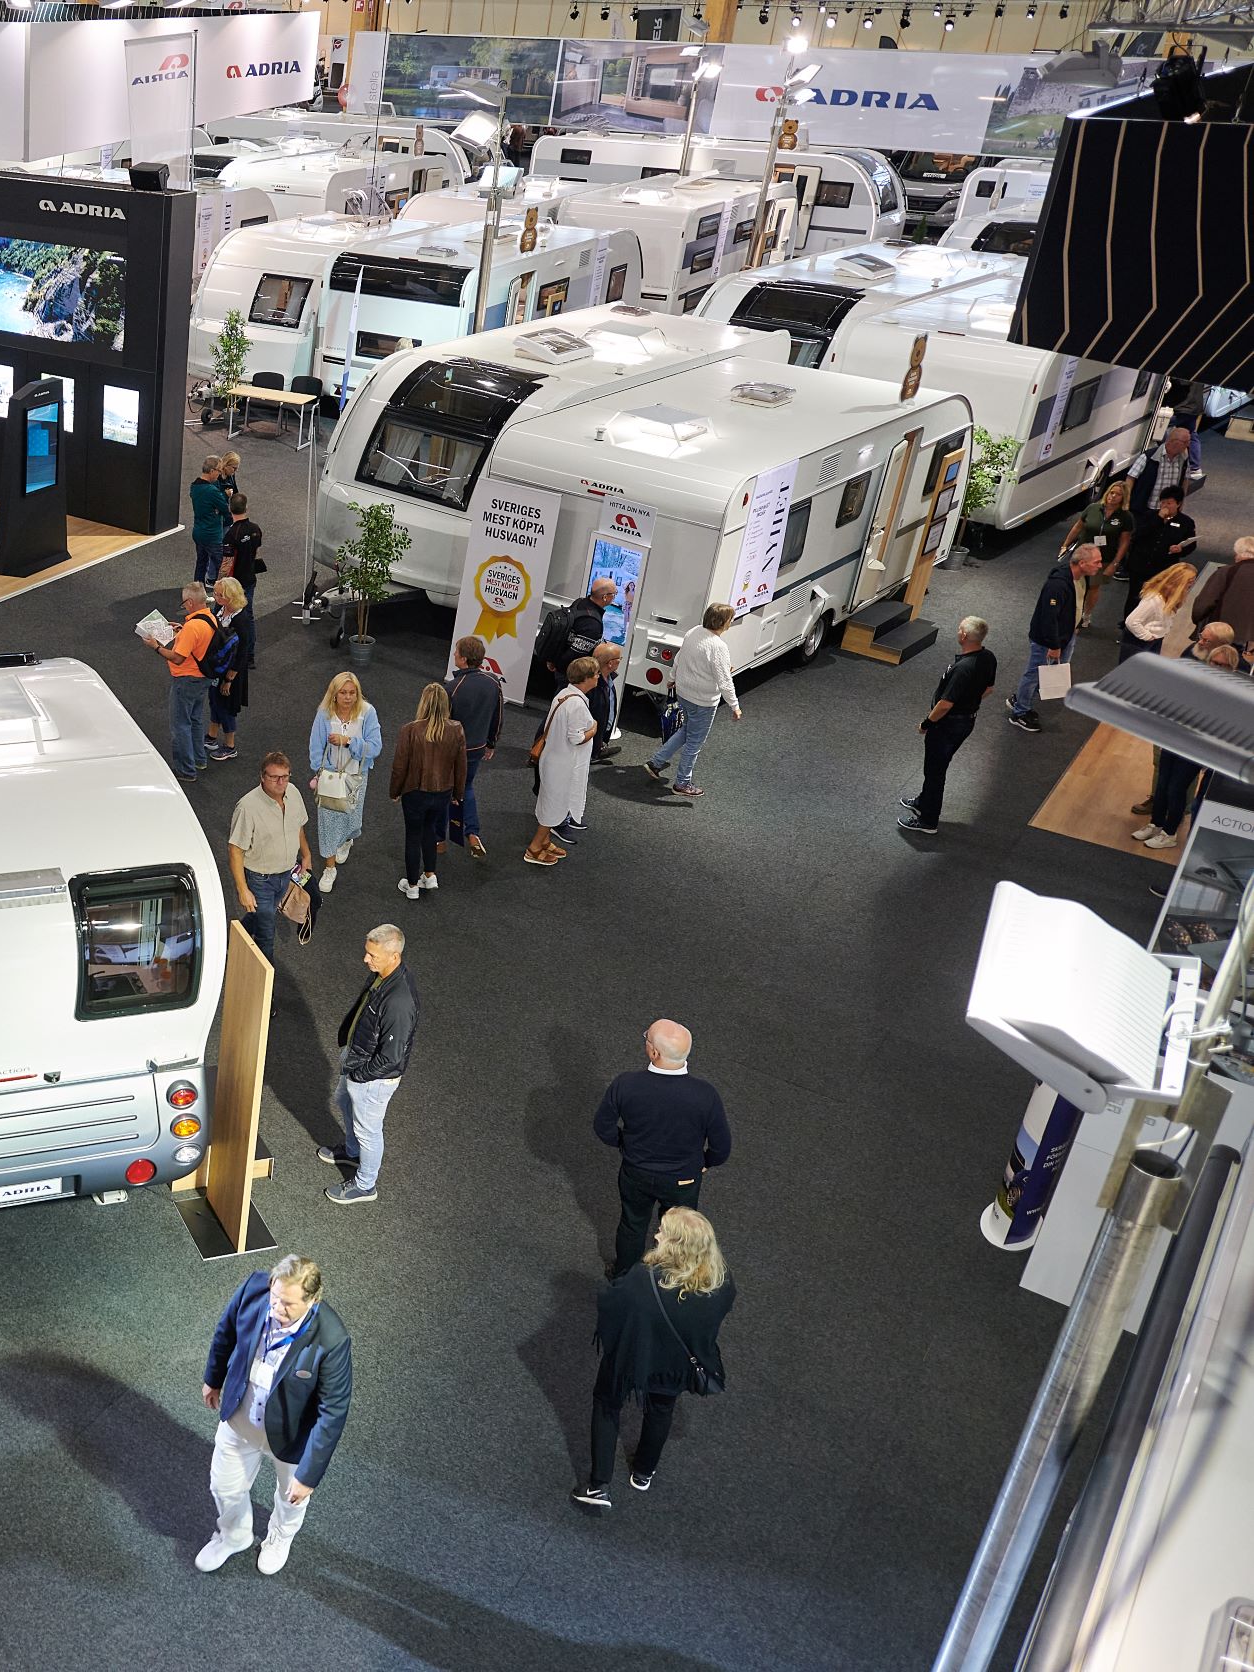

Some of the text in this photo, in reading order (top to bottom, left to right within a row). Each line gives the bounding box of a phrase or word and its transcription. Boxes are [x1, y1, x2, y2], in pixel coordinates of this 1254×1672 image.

[245, 60, 301, 78] ADRIA
[59, 202, 126, 220] ADRIA
[591, 482, 625, 495] ADRIA
[491, 498, 542, 519] SVERIGES
[609, 501, 651, 518] HITTA DIN NYA
[482, 511, 545, 535] MEST KÖPTA
[609, 524, 642, 538] ADRIA
[761, 481, 790, 573] NYHET
[485, 526, 537, 548] HUSVAGN!
[486, 577, 519, 591] MEST KÖPTA
[487, 569, 521, 584] SVERIGES
[484, 585, 518, 600] HUSVAGN
[2, 1185, 52, 1197] ADRIA
